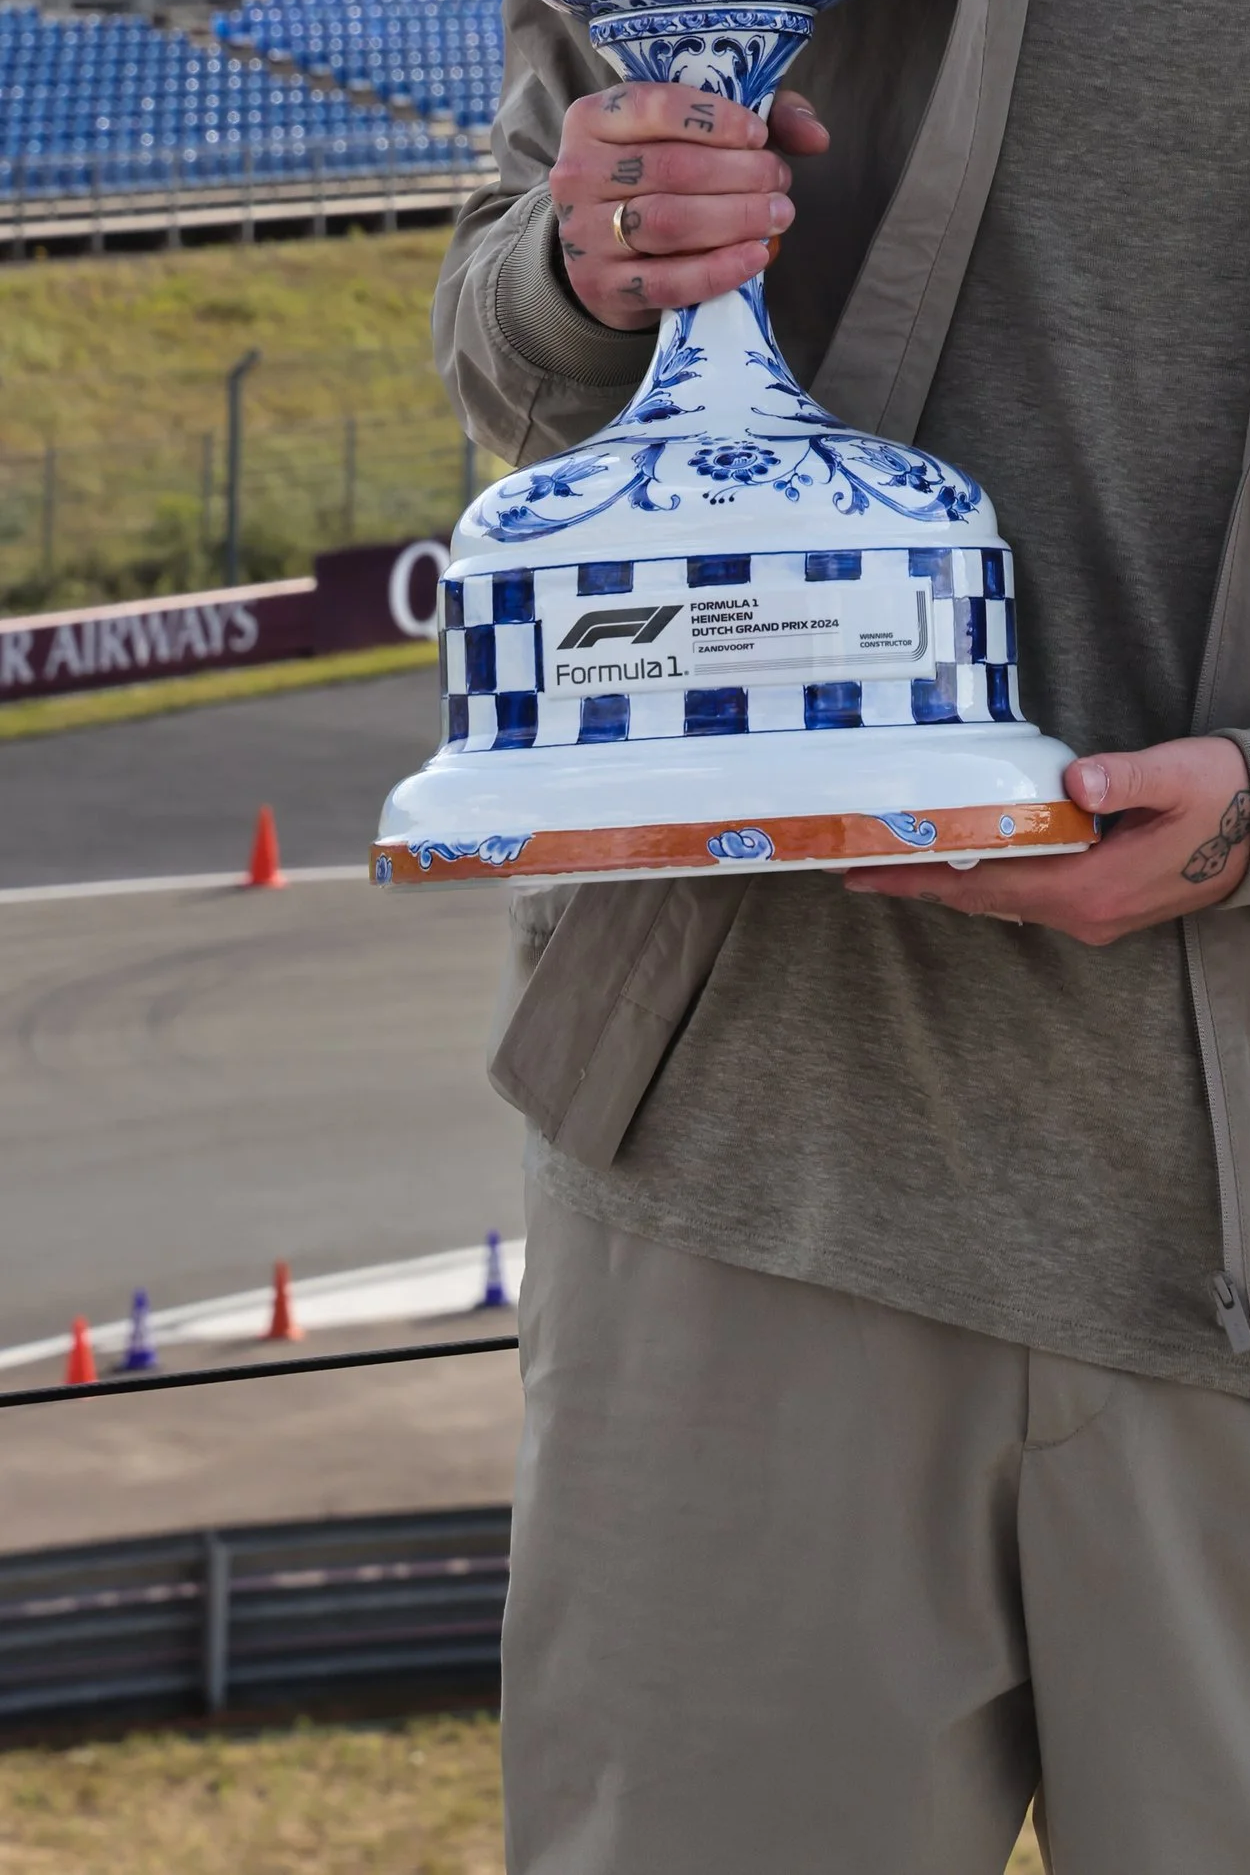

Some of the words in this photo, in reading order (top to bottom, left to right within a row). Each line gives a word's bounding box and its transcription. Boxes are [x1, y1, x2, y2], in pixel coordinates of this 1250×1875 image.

[690, 599, 750, 611] FORMULA
[752, 598, 759, 607] 1
[691, 611, 753, 624] HEINEKEN
[692, 625, 733, 637] DUTCH
[736, 622, 779, 634] GRAND
[782, 620, 808, 631] PRIX
[810, 619, 839, 629] 2024
[44, 600, 259, 681] AIRWAYS
[859, 632, 893, 640] WINNING
[698, 643, 755, 653] ZANDVOORT
[860, 639, 912, 648] CONSTRUCTOR
